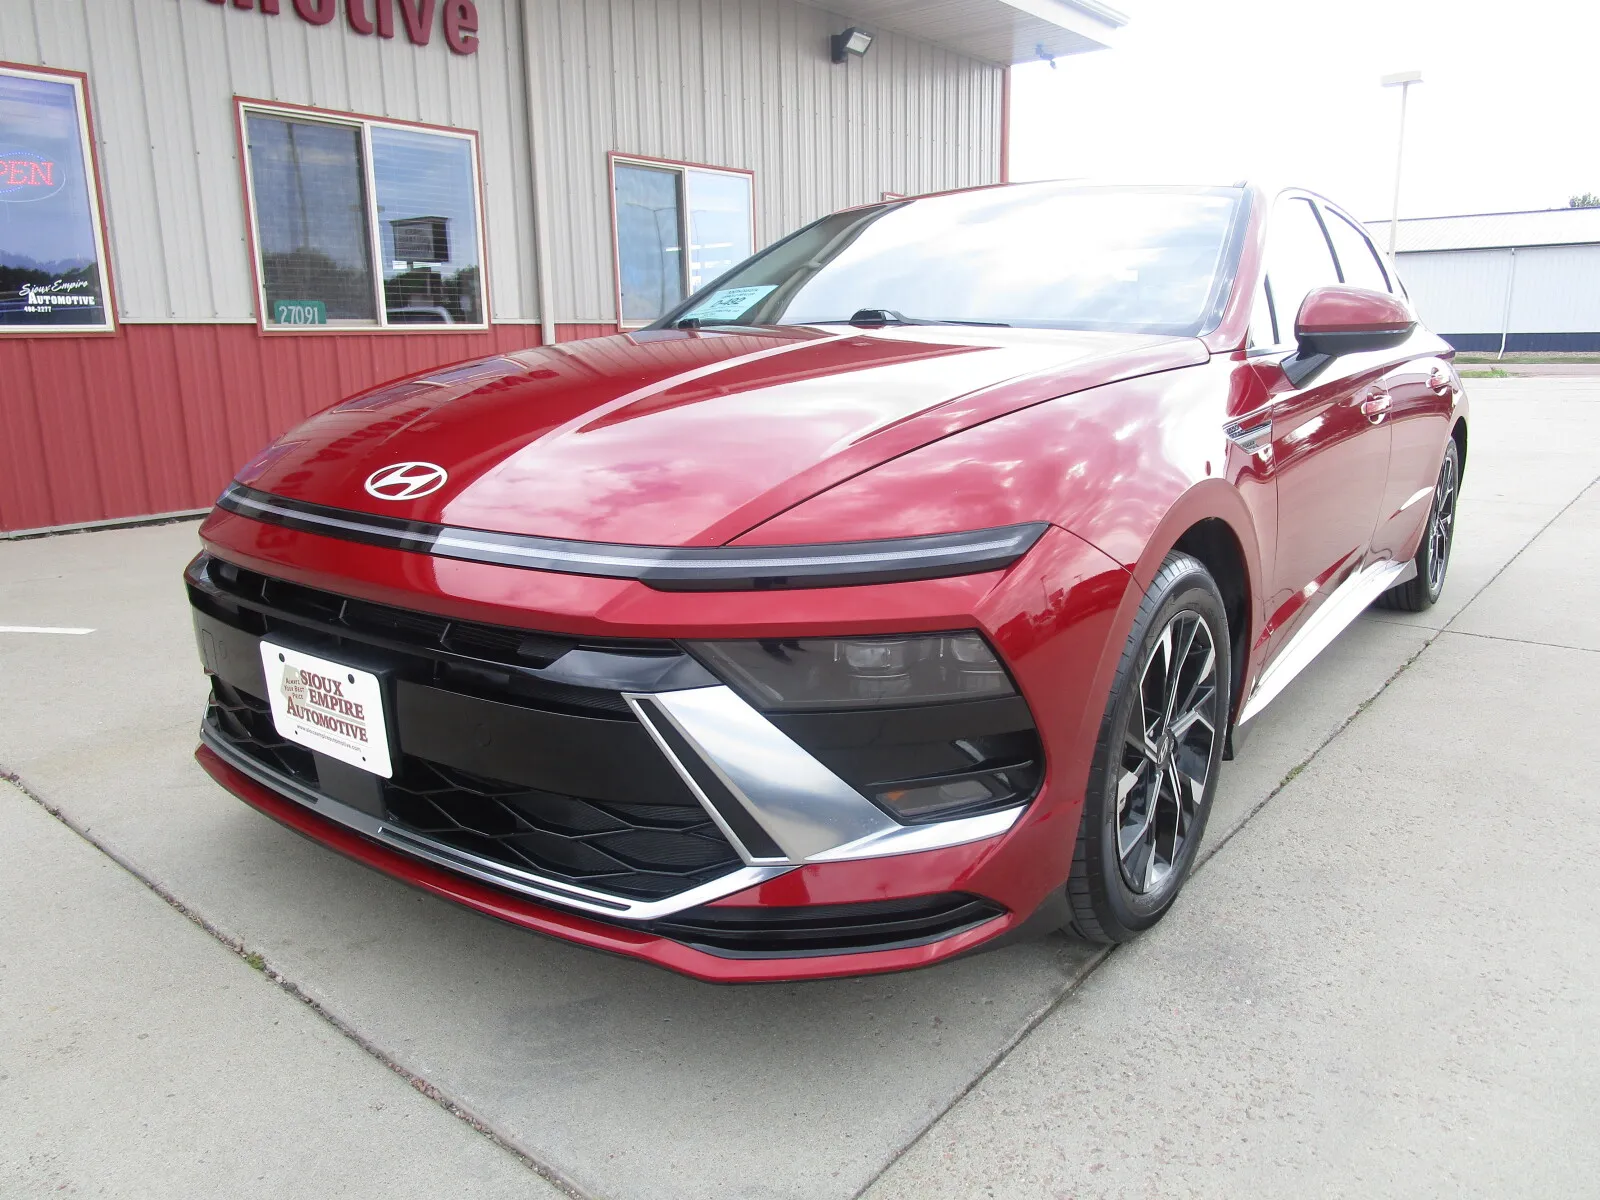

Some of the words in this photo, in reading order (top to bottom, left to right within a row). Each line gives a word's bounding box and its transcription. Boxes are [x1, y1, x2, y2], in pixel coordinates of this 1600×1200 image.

[19, 283, 51, 296] Sioux
[51, 279, 88, 292] Empire
[28, 291, 95, 305] AUTOMOTIVE
[279, 305, 319, 325] 27091
[300, 669, 344, 698] SIOUX
[308, 688, 365, 720] EMPIRE
[286, 696, 369, 743] AUTOMOTIVE
